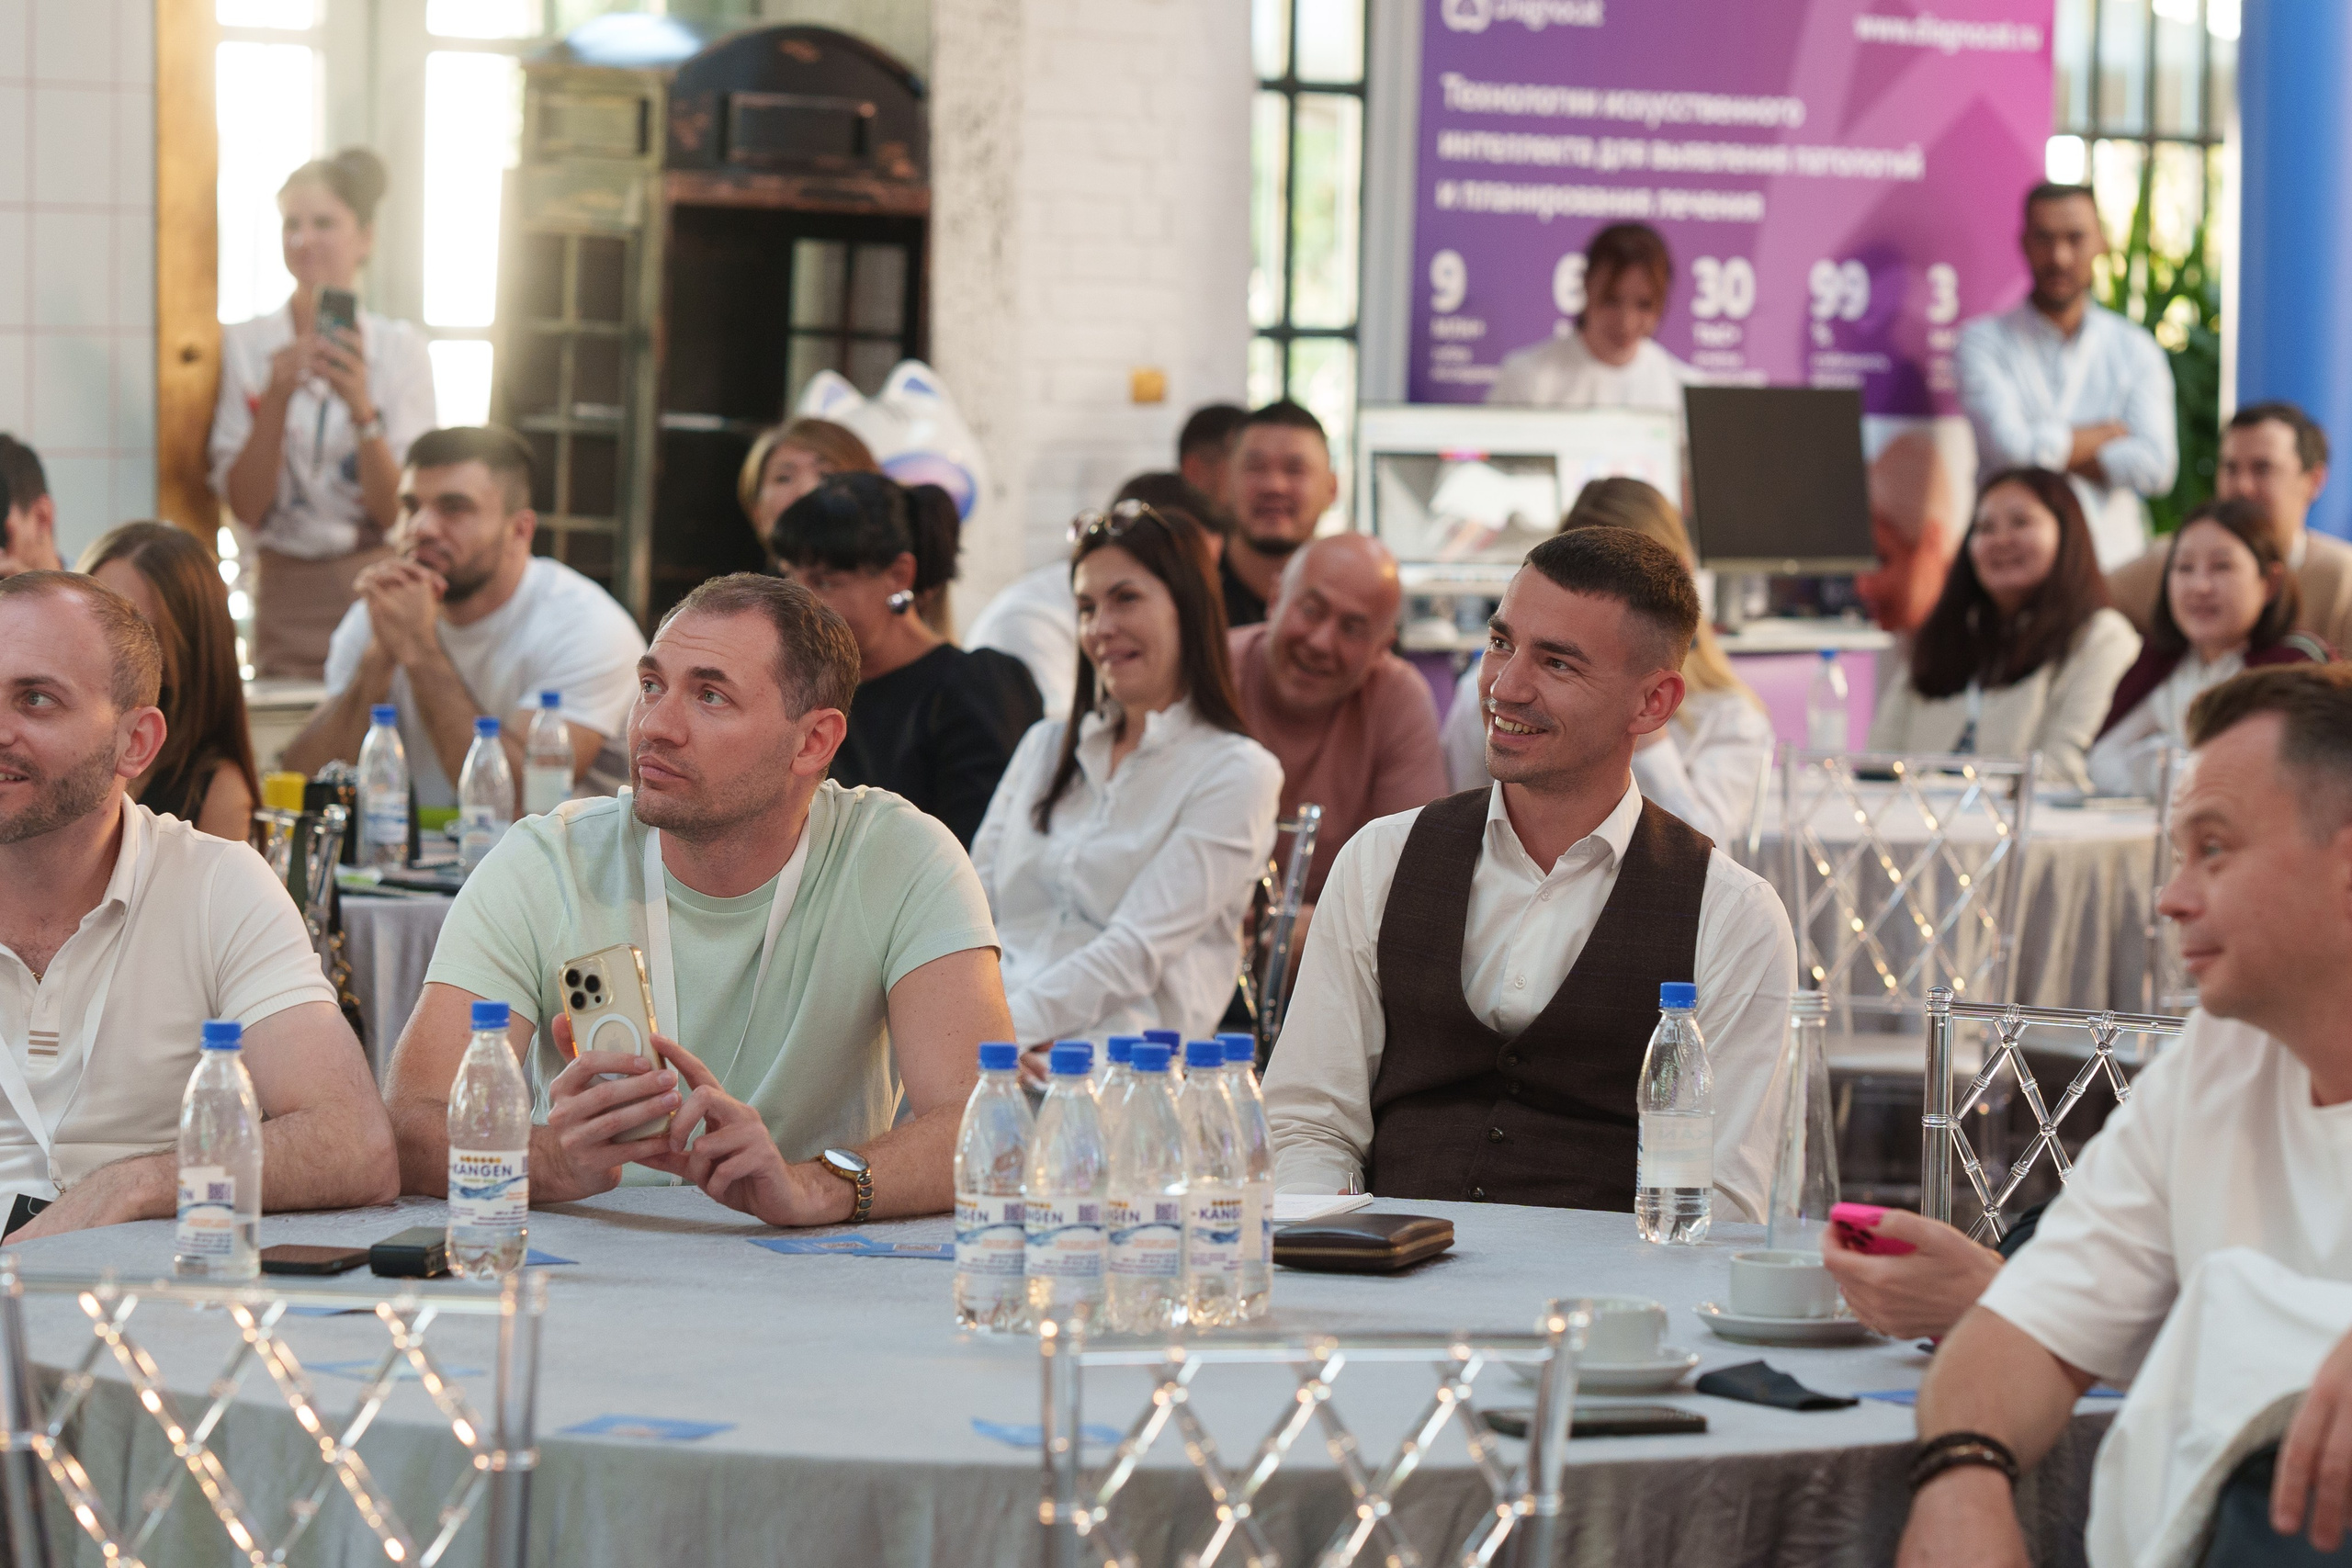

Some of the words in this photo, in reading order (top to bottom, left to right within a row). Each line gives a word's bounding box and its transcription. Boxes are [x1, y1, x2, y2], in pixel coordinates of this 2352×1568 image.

[1440, 73, 1598, 118] Технологии
[1604, 89, 1805, 130] искусственного
[1437, 130, 1592, 168] интеллекта
[1596, 137, 1645, 174] для
[1435, 180, 1456, 211] и
[1463, 180, 1650, 223] планирования
[1657, 187, 1765, 223] лечения
[1430, 249, 1466, 313] 9
[1690, 256, 1755, 320] 30
[1808, 259, 1871, 321] 99
[1927, 263, 1960, 324] 3
